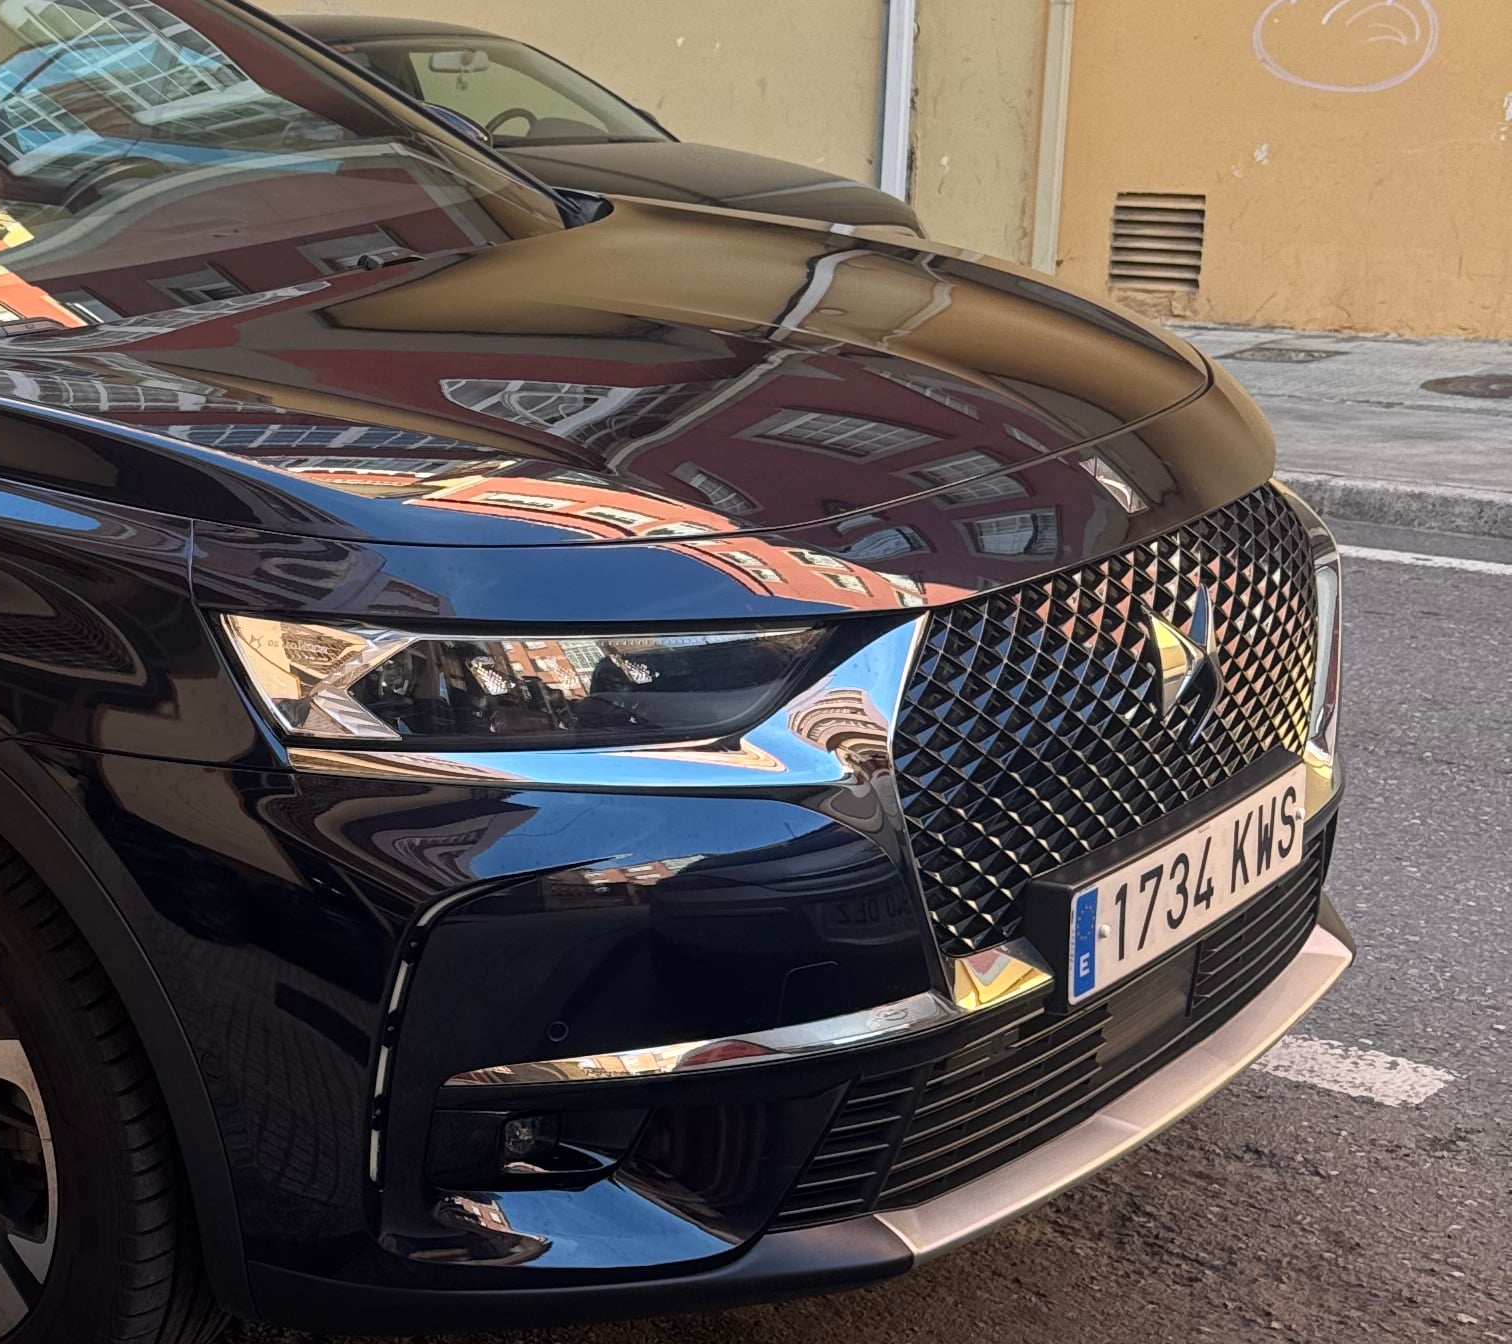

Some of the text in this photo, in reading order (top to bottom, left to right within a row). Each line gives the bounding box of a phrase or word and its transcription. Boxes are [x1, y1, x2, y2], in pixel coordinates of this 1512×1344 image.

[1115, 786, 1297, 961] 1734 KWS
[1079, 952, 1090, 977] E
